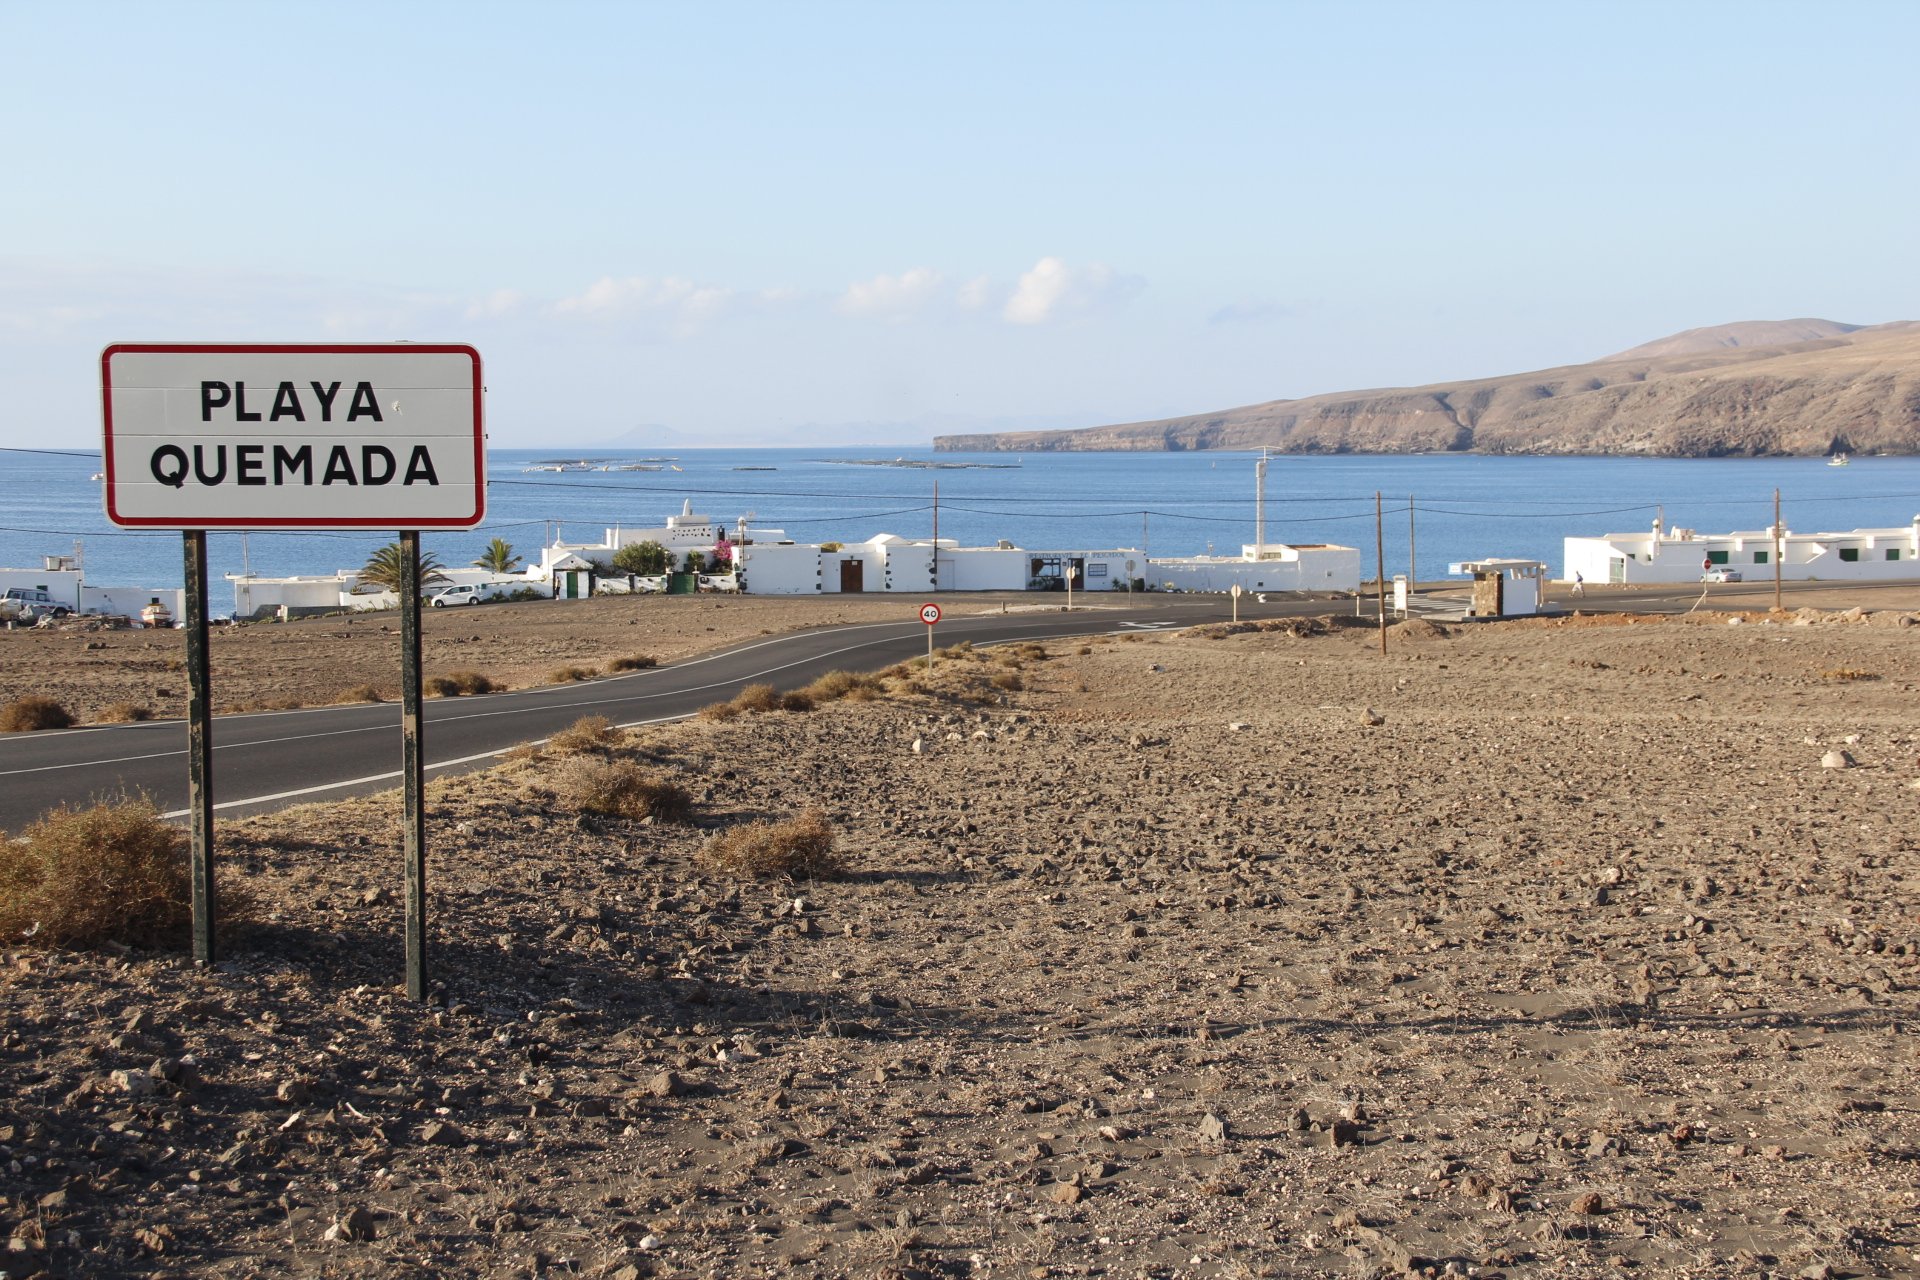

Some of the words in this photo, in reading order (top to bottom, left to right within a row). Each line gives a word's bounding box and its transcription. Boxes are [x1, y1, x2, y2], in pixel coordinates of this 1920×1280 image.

[201, 381, 384, 422] PLAYA
[150, 444, 440, 489] QUEMADA
[924, 610, 937, 618] 40
